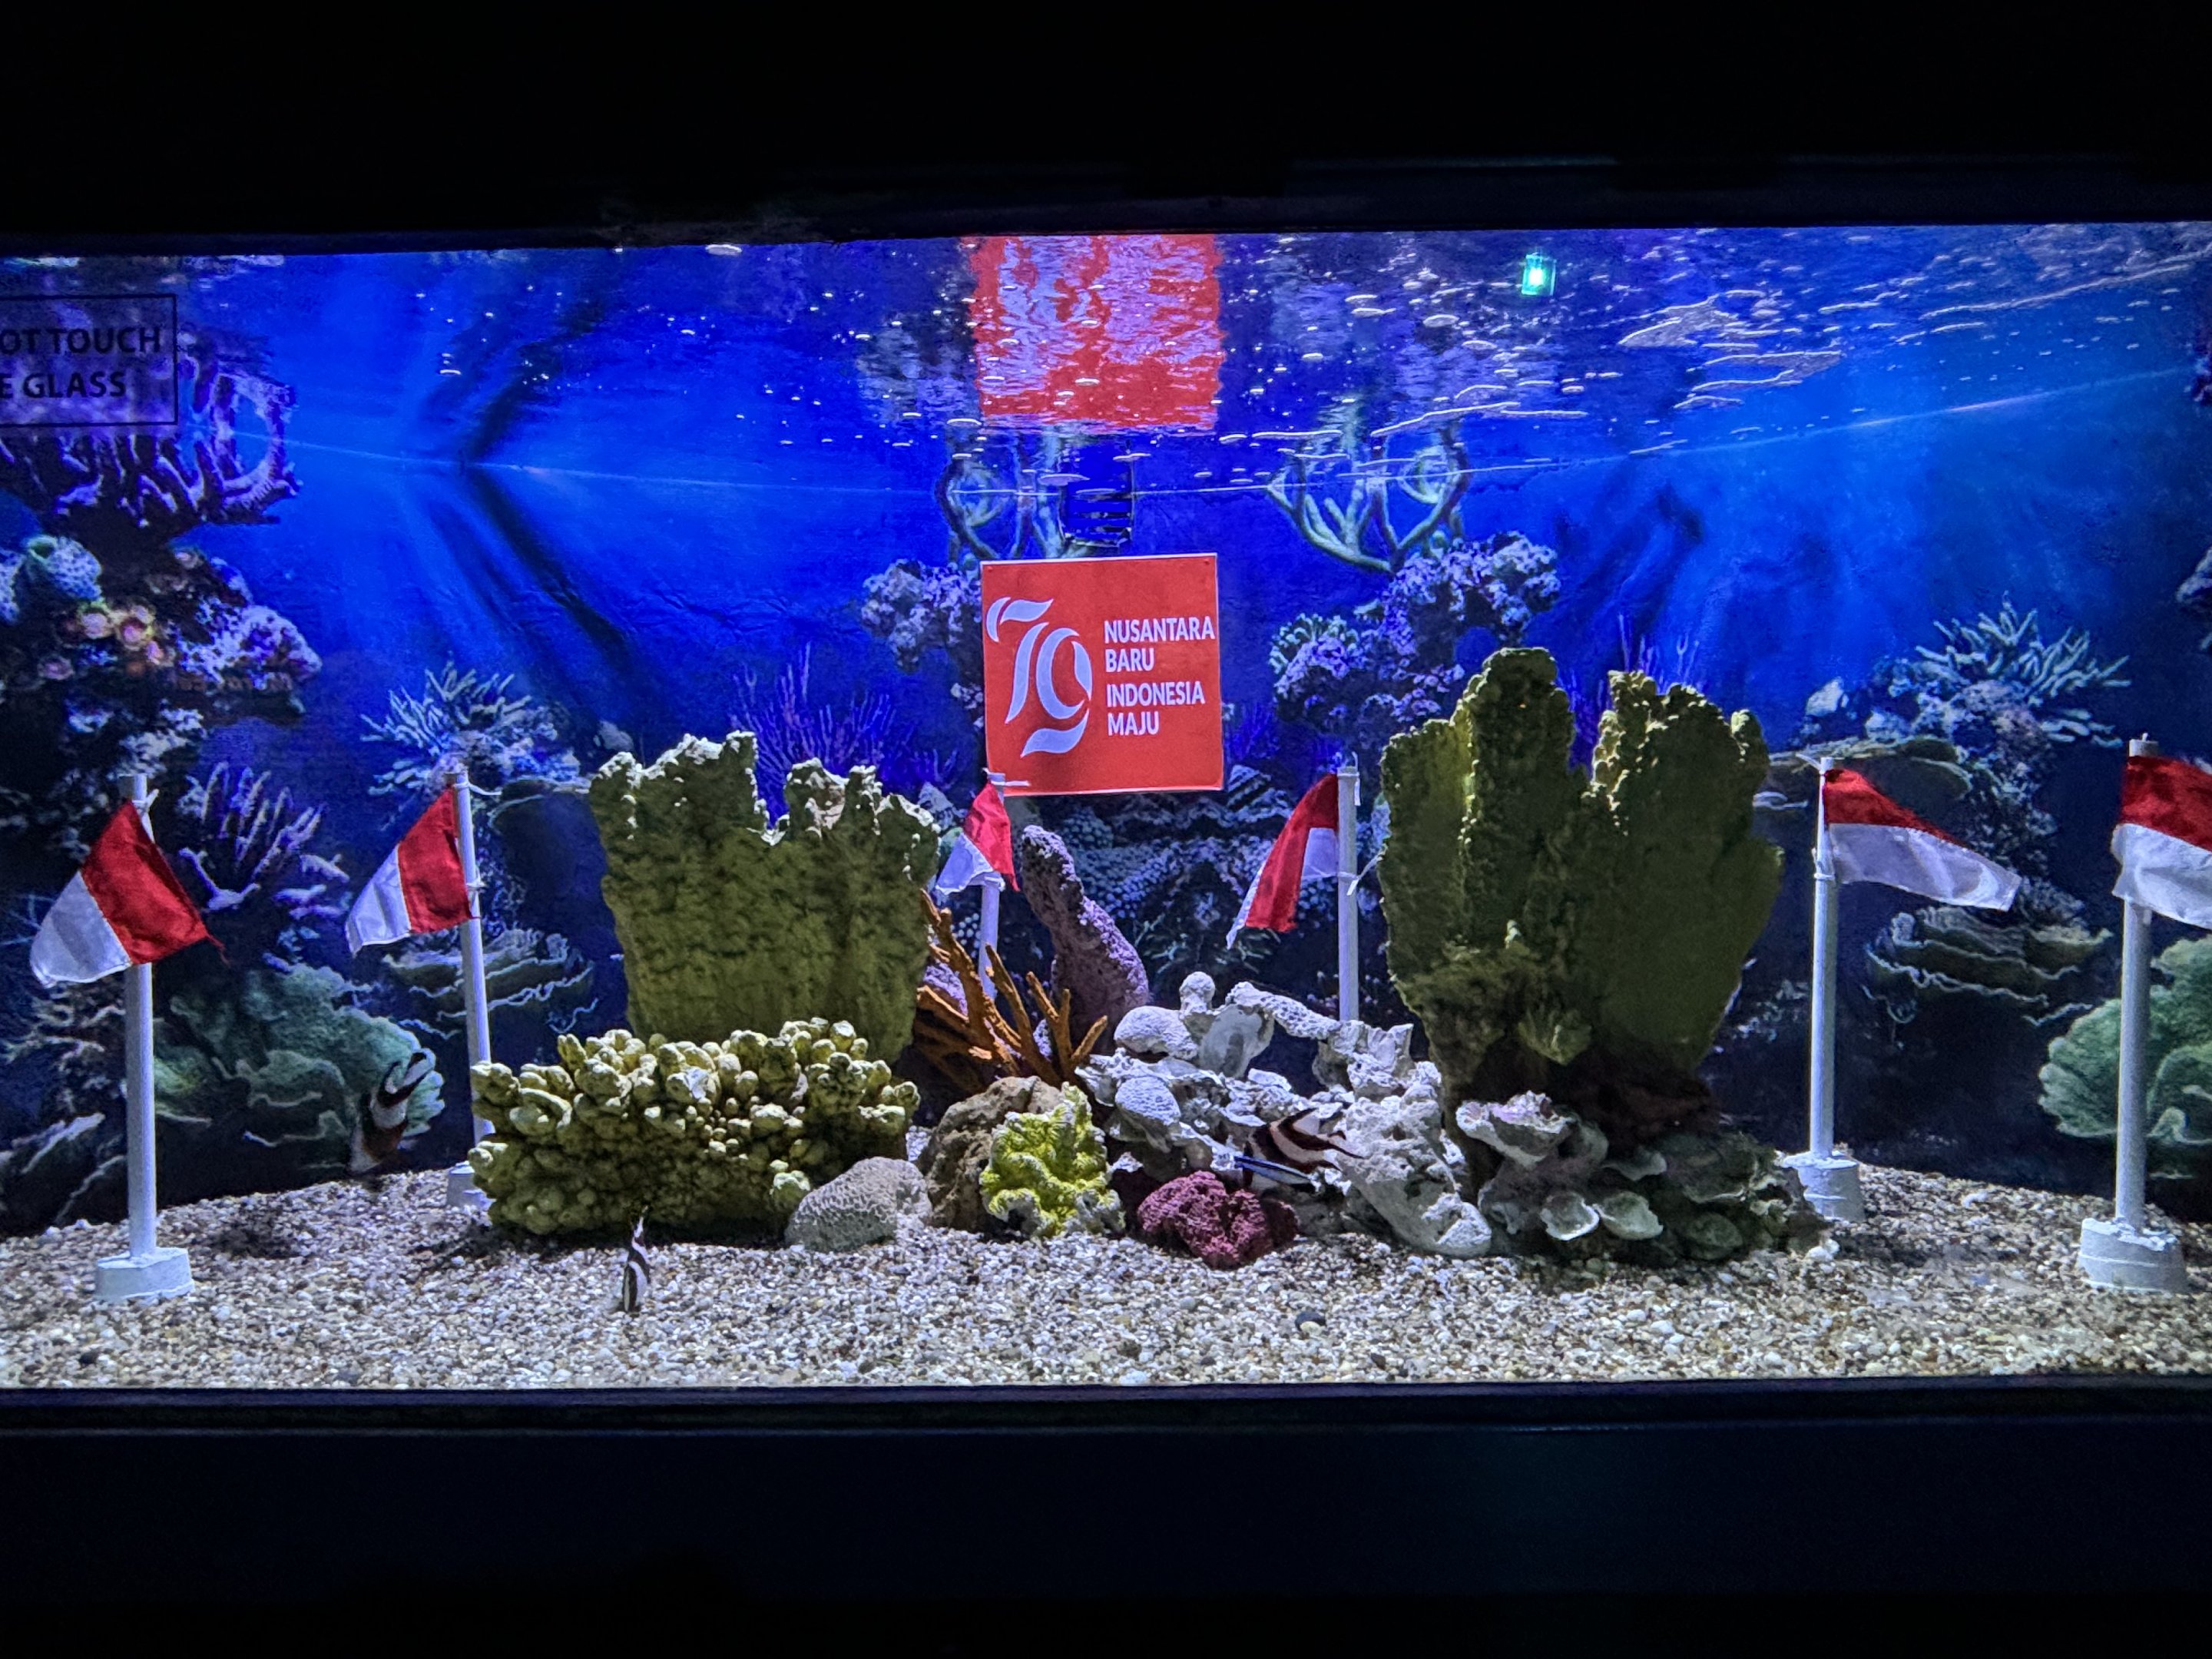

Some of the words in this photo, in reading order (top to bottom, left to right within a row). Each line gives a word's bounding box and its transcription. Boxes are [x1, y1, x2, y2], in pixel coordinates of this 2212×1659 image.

[46, 326, 161, 354] TOUCH
[23, 372, 126, 398] GLASS
[1104, 616, 1215, 644] NUSANTARA
[1105, 648, 1155, 673] BARU
[1107, 680, 1206, 707] INDONESIA
[1108, 710, 1160, 736] MAJU
